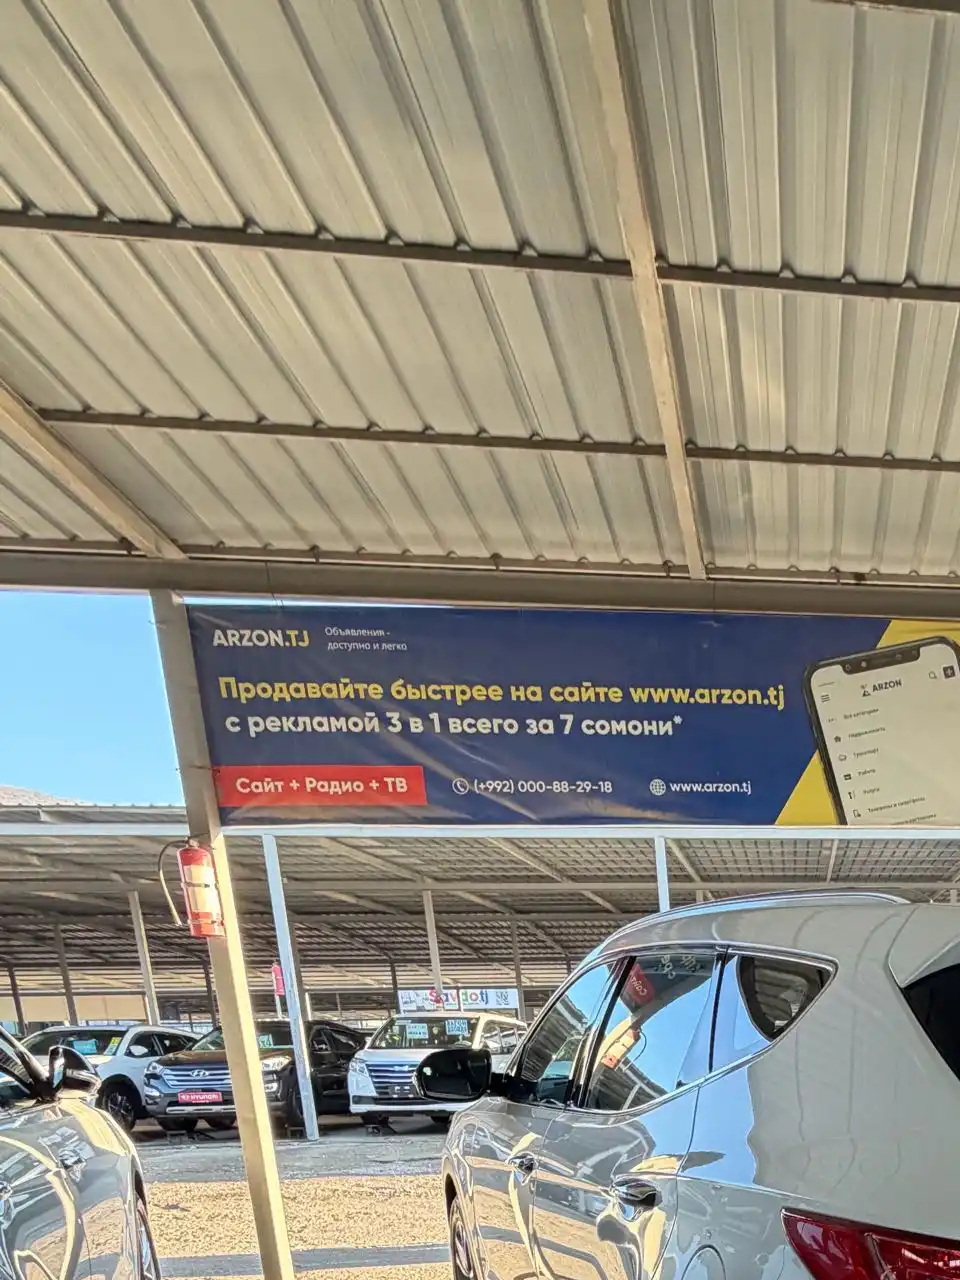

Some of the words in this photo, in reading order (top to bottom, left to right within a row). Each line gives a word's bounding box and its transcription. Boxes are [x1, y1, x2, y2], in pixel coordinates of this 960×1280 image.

[213, 629, 310, 648] ARZON.TJ
[324, 627, 386, 637] Объявления
[327, 641, 371, 652] доступно
[373, 642, 380, 650] и
[381, 642, 408, 651] легко
[218, 676, 384, 704] Продавайте
[390, 678, 504, 706] быстрее
[510, 685, 543, 702] на
[549, 681, 624, 703] сайте
[629, 684, 785, 711] www.arzon.tj
[872, 679, 903, 693] ARZON
[225, 715, 241, 733] с
[247, 711, 380, 738] рекламой
[385, 711, 403, 733] 3
[409, 717, 425, 733] в
[428, 712, 441, 734] 1
[448, 716, 519, 734] всего
[525, 718, 555, 735] за
[559, 713, 575, 735] 7
[235, 777, 285, 794] Сайт
[305, 777, 364, 795] Радио
[383, 777, 408, 793] ТВ
[473, 779, 514, 795] (+992)
[518, 780, 613, 793] 000-88-29-18
[670, 780, 752, 796] www.arzon.tj
